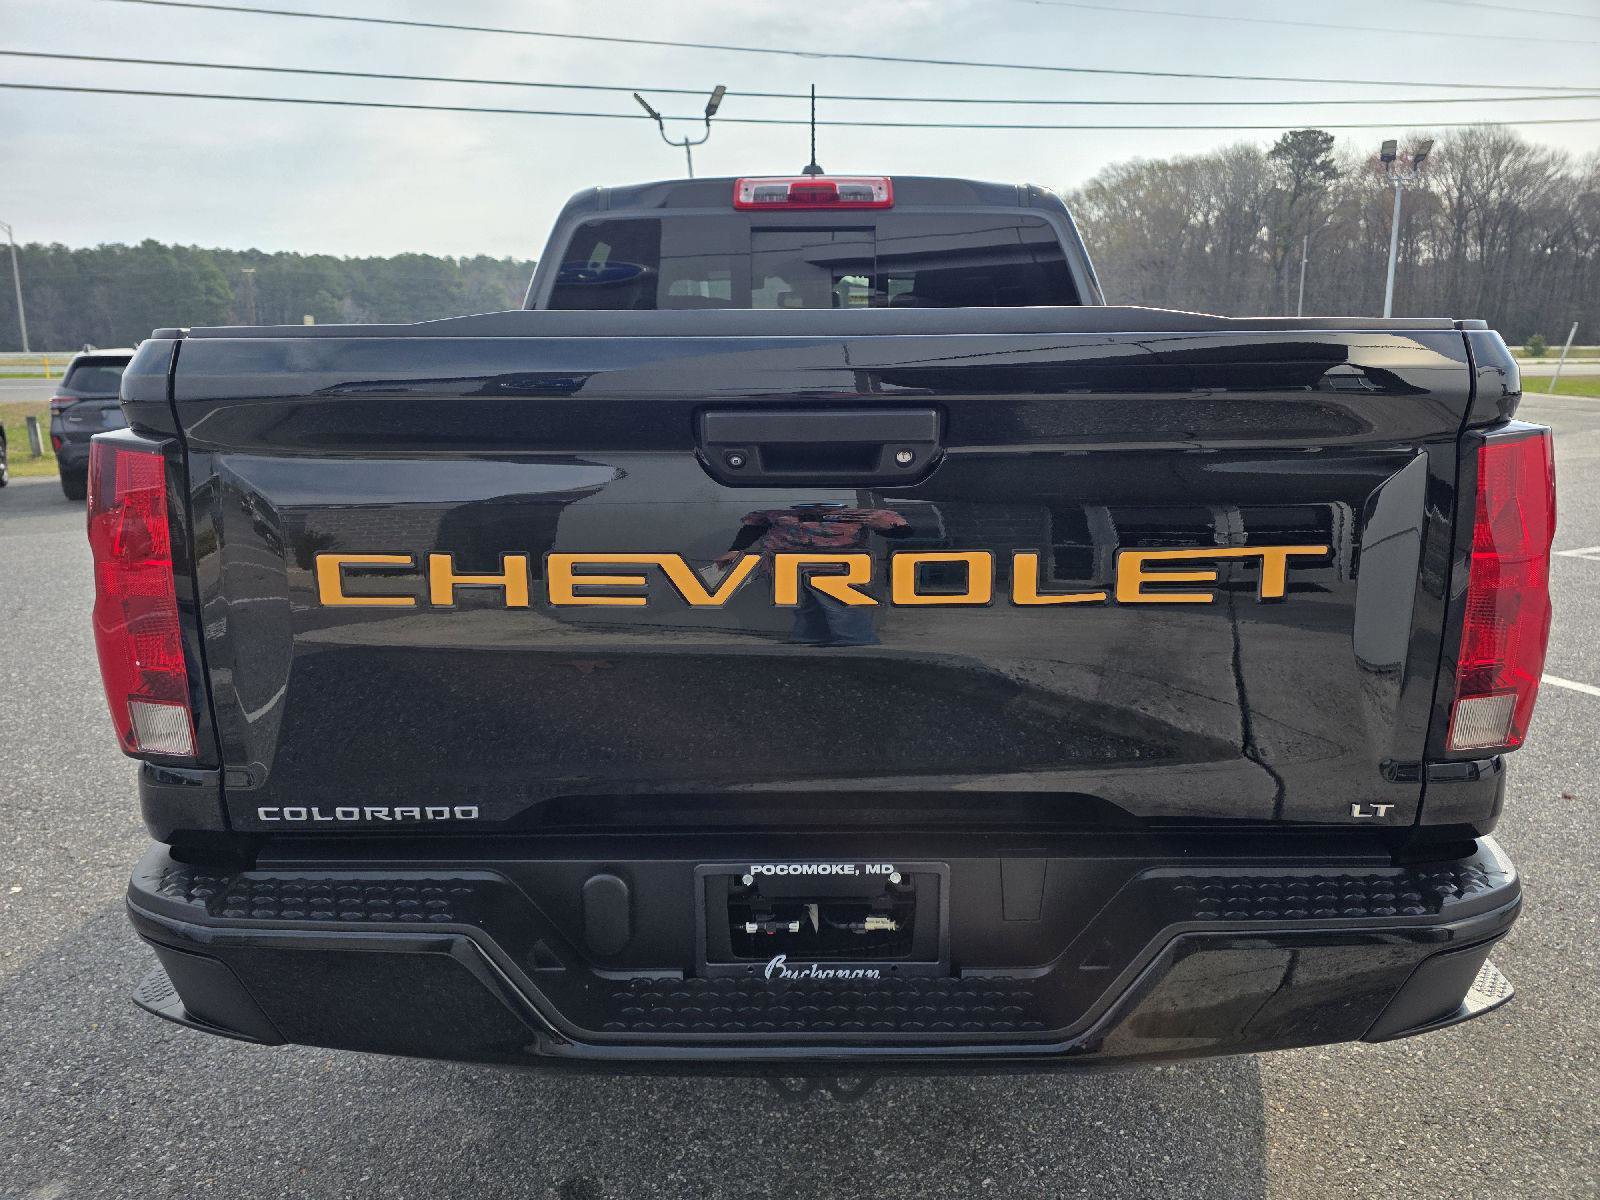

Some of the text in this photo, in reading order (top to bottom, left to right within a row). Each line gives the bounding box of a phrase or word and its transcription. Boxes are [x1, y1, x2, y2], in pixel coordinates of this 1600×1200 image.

[315, 545, 1329, 607] CHEVROLET
[257, 806, 479, 821] COLORADO
[1351, 803, 1395, 818] LT
[750, 864, 895, 876] POCOMOKE, MD
[764, 954, 881, 980] Buchanan
